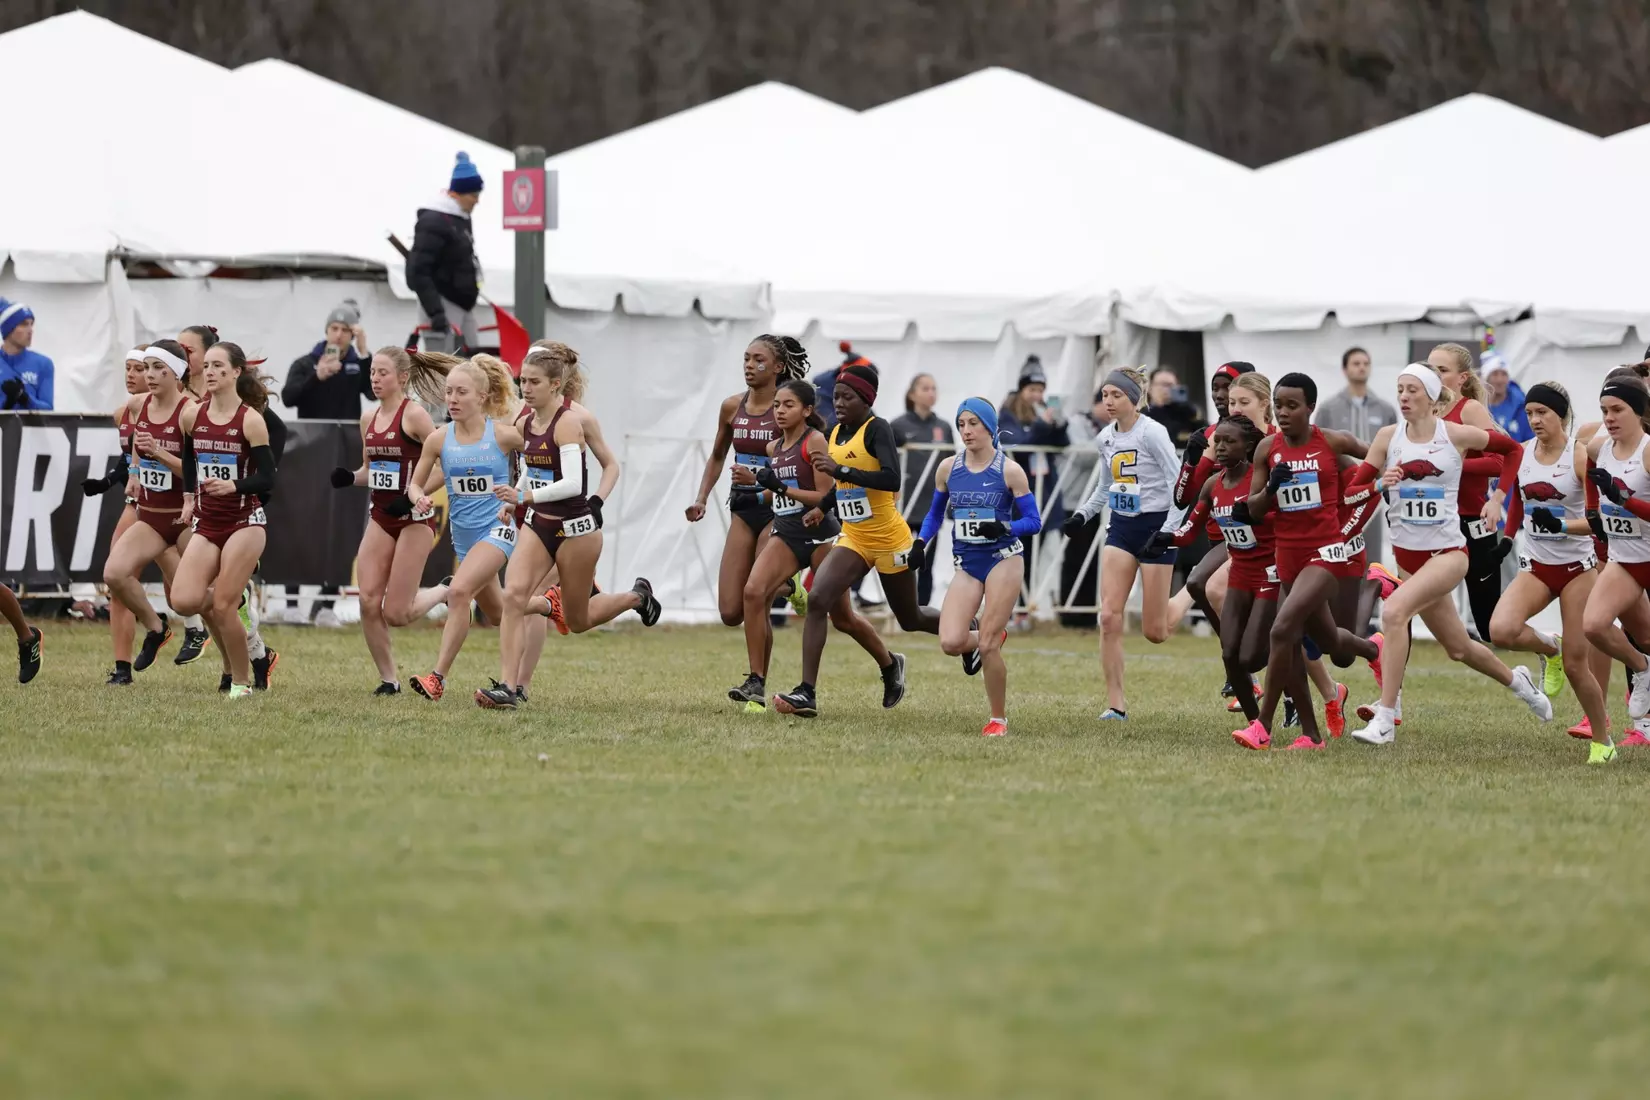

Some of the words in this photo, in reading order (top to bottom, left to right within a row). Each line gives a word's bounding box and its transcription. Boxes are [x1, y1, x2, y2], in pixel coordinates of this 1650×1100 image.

[750, 429, 773, 440] STATE
[213, 440, 242, 453] COLLEGE
[203, 465, 230, 481] 138
[779, 465, 797, 478] STATE
[1110, 449, 1138, 484] C
[1287, 459, 1319, 472] ABAMA
[143, 470, 166, 487] 137
[372, 471, 393, 488] 135
[458, 477, 487, 493] 160
[0, 426, 122, 571] RT
[1114, 493, 1135, 511] 154
[1282, 485, 1311, 504] 101
[841, 500, 865, 518] 115
[1405, 501, 1437, 518] 116
[569, 518, 592, 535] 153
[960, 521, 979, 537] 15
[1606, 517, 1633, 534] 123
[498, 527, 516, 543] 160
[1224, 528, 1248, 544] 113
[1327, 545, 1345, 560] 101
